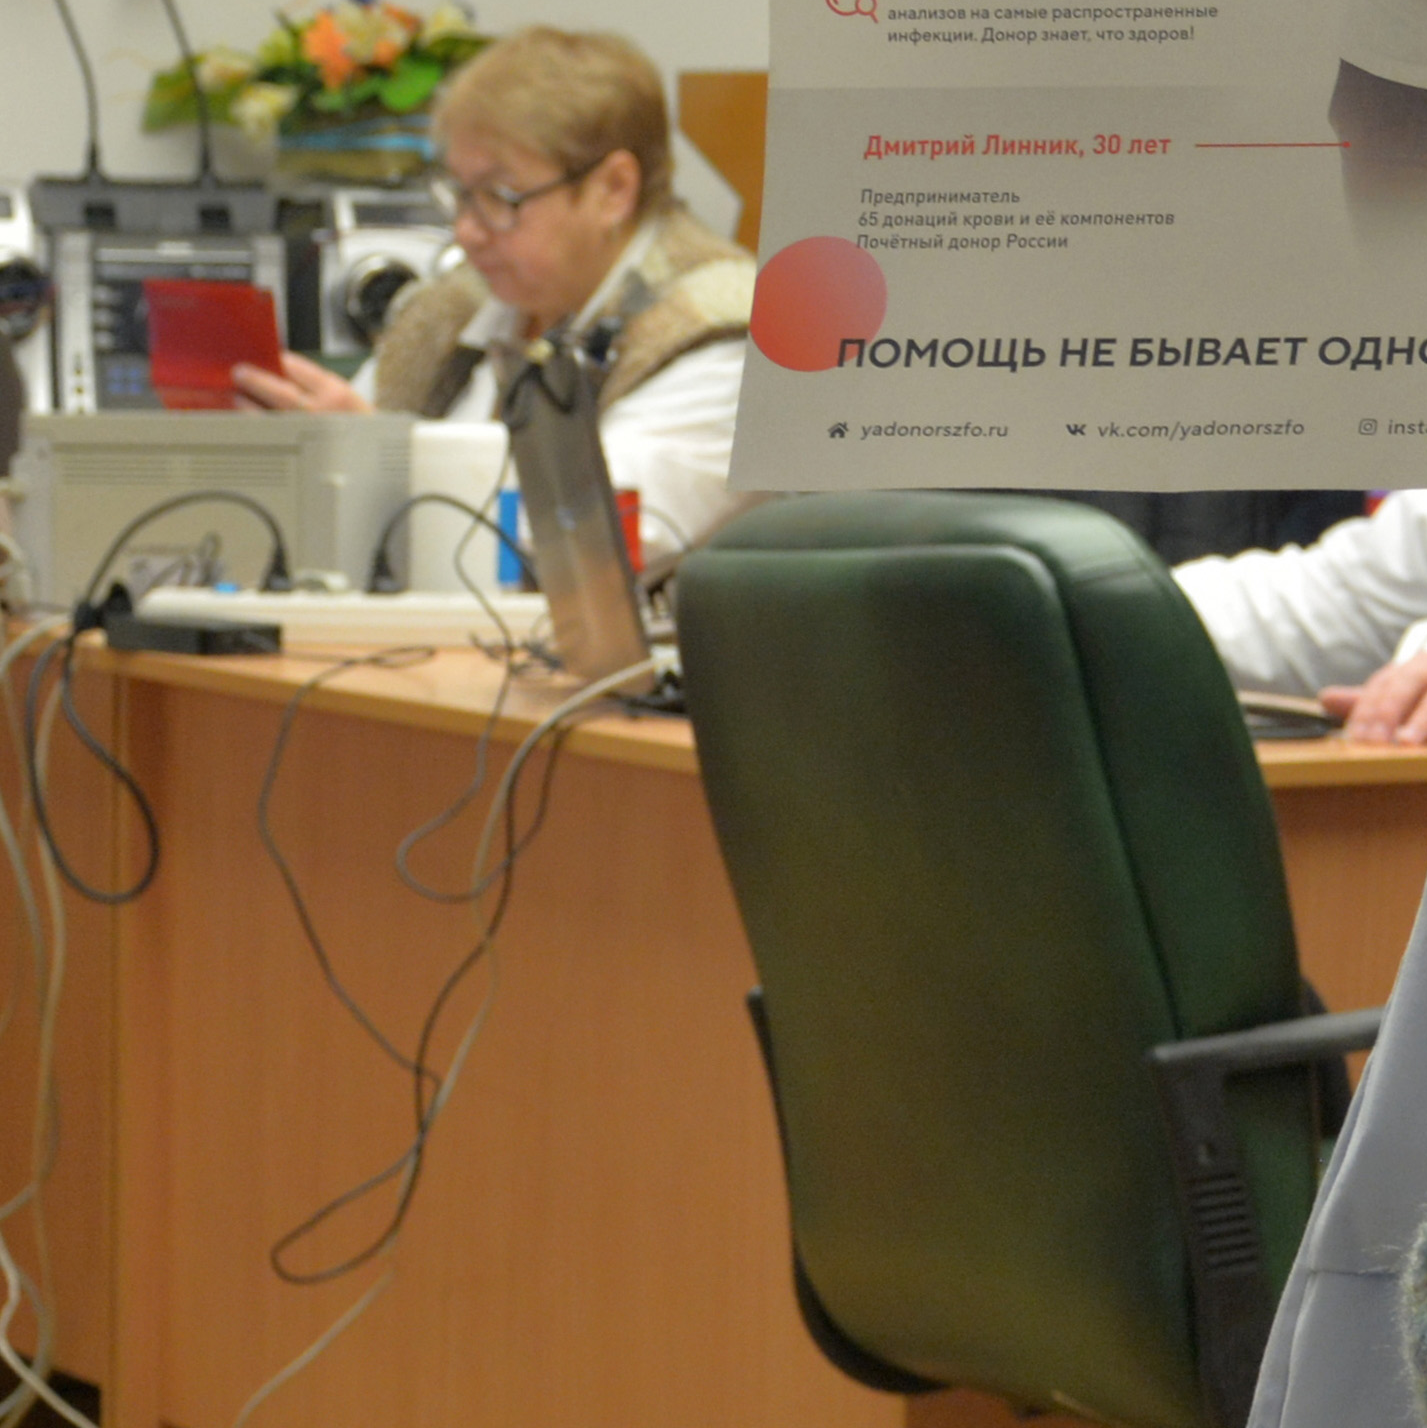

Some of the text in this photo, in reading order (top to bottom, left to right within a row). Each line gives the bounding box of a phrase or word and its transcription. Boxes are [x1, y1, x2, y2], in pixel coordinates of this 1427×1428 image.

[887, 5, 1219, 23] анализов на самые распространенные
[886, 24, 1195, 46] инфекции. Донор знает, что здоров!
[863, 133, 1172, 161] Дмитрий Линник, 30 лет
[860, 187, 1021, 209] Предприниматель
[857, 210, 1175, 231] 65 донаций крови и её компонентов
[856, 232, 1069, 254] Почётный донор России
[836, 337, 1047, 373] ПОМОЩЬ
[1059, 337, 1118, 368] НЕ
[1129, 336, 1308, 368] БЫВАЕТ
[860, 420, 1009, 442] yadonorszfo.ru
[1097, 418, 1305, 442] vk.com/yadonorszfo
